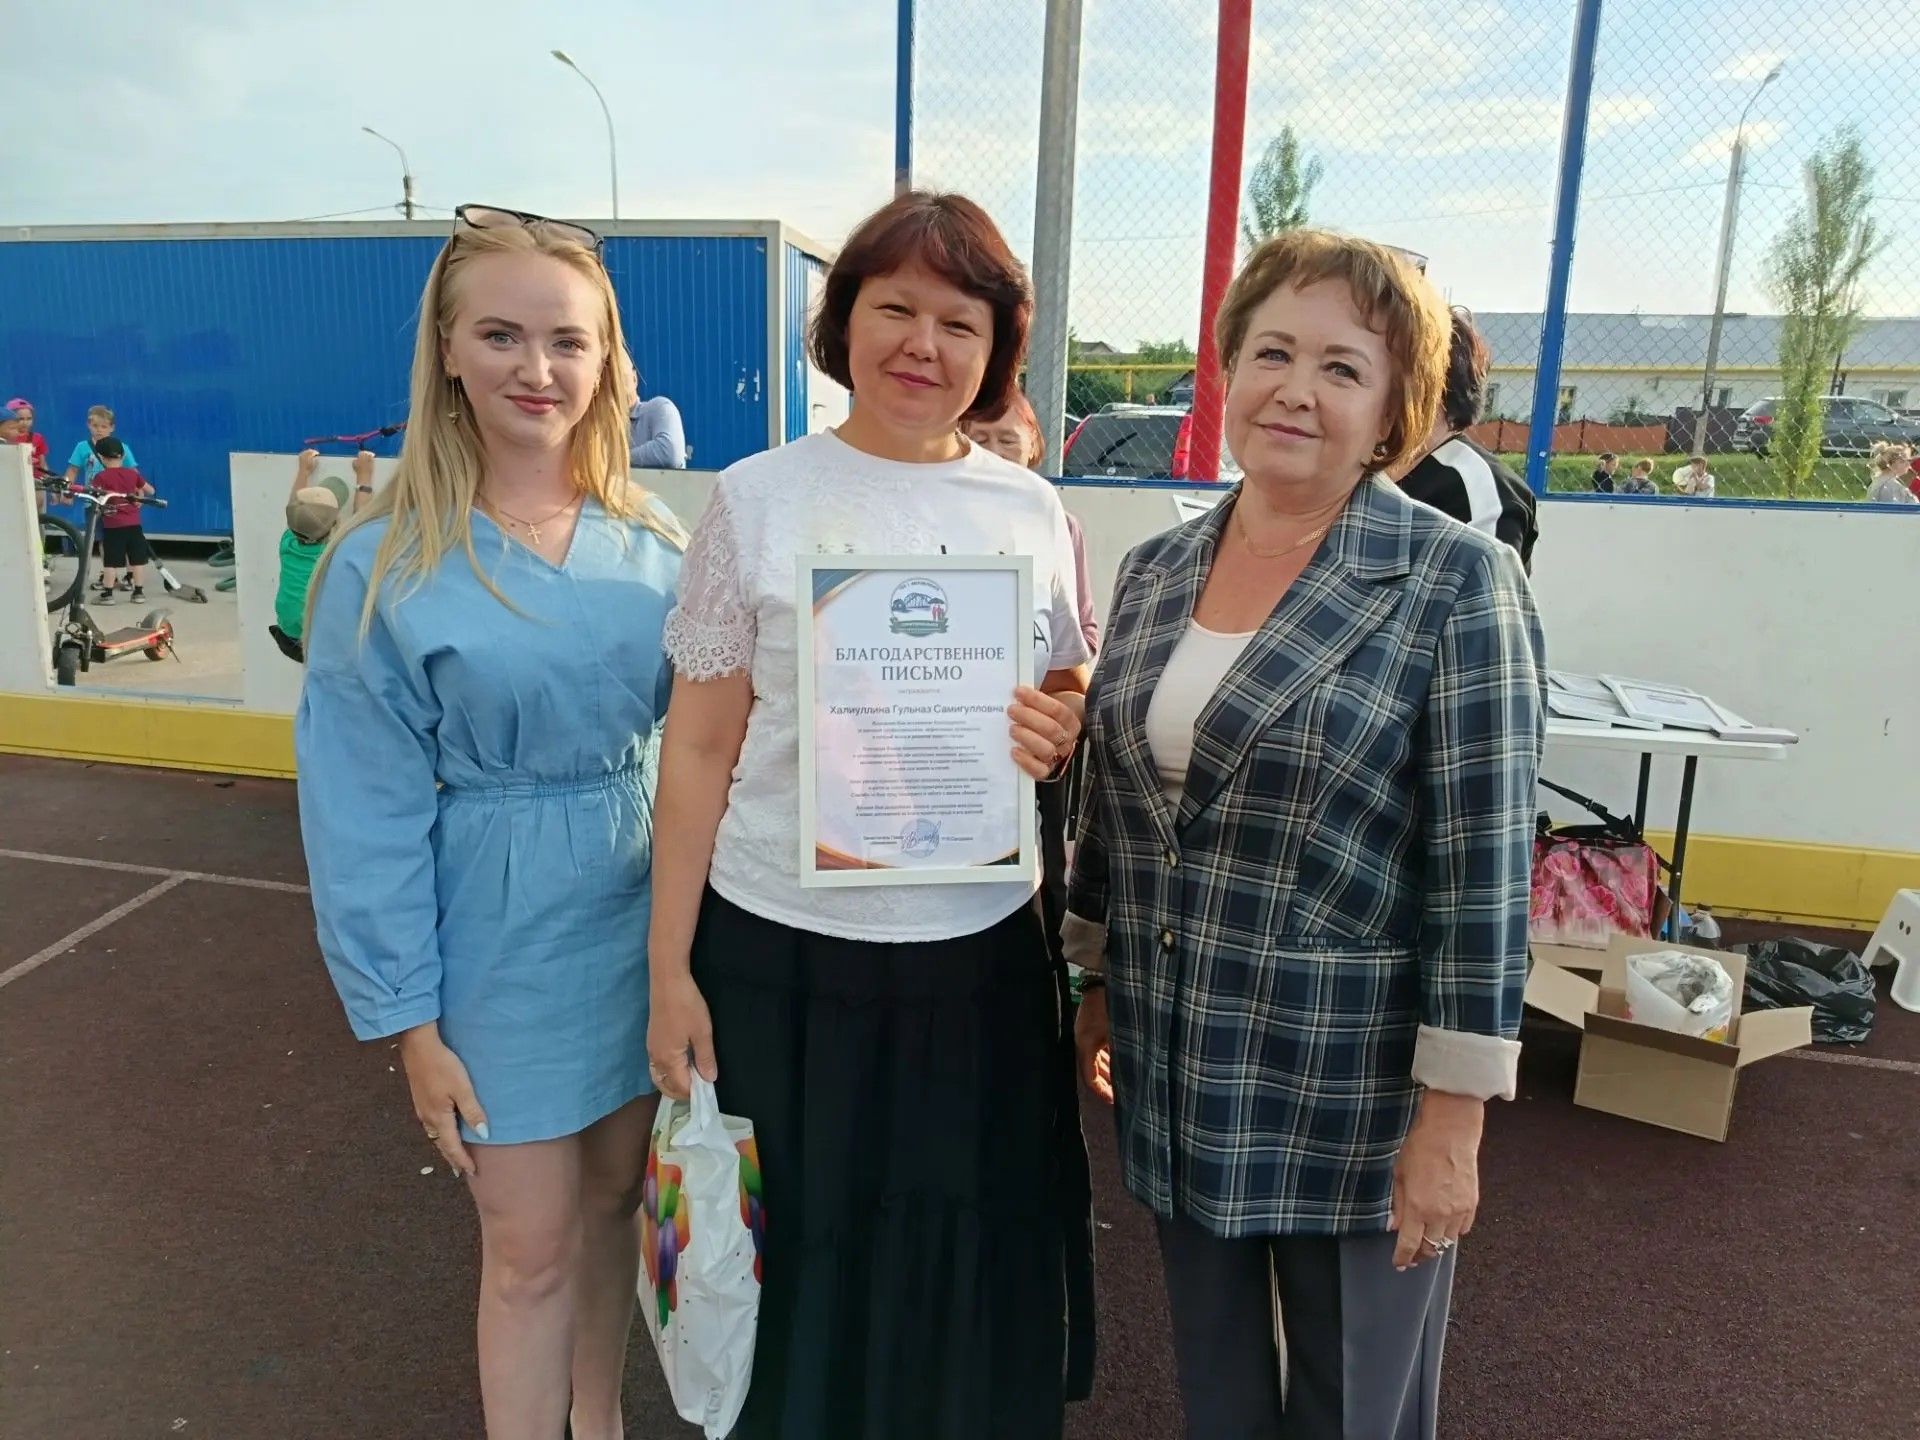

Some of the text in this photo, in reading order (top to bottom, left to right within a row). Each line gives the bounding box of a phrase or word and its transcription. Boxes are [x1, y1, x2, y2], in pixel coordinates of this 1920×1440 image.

[836, 647, 1005, 661] БЛАГОДАРСТВЕННОЕ
[881, 665, 963, 681] ПИСЬМО
[829, 704, 1004, 716] Халиуллина Гульназ Самигулловна
